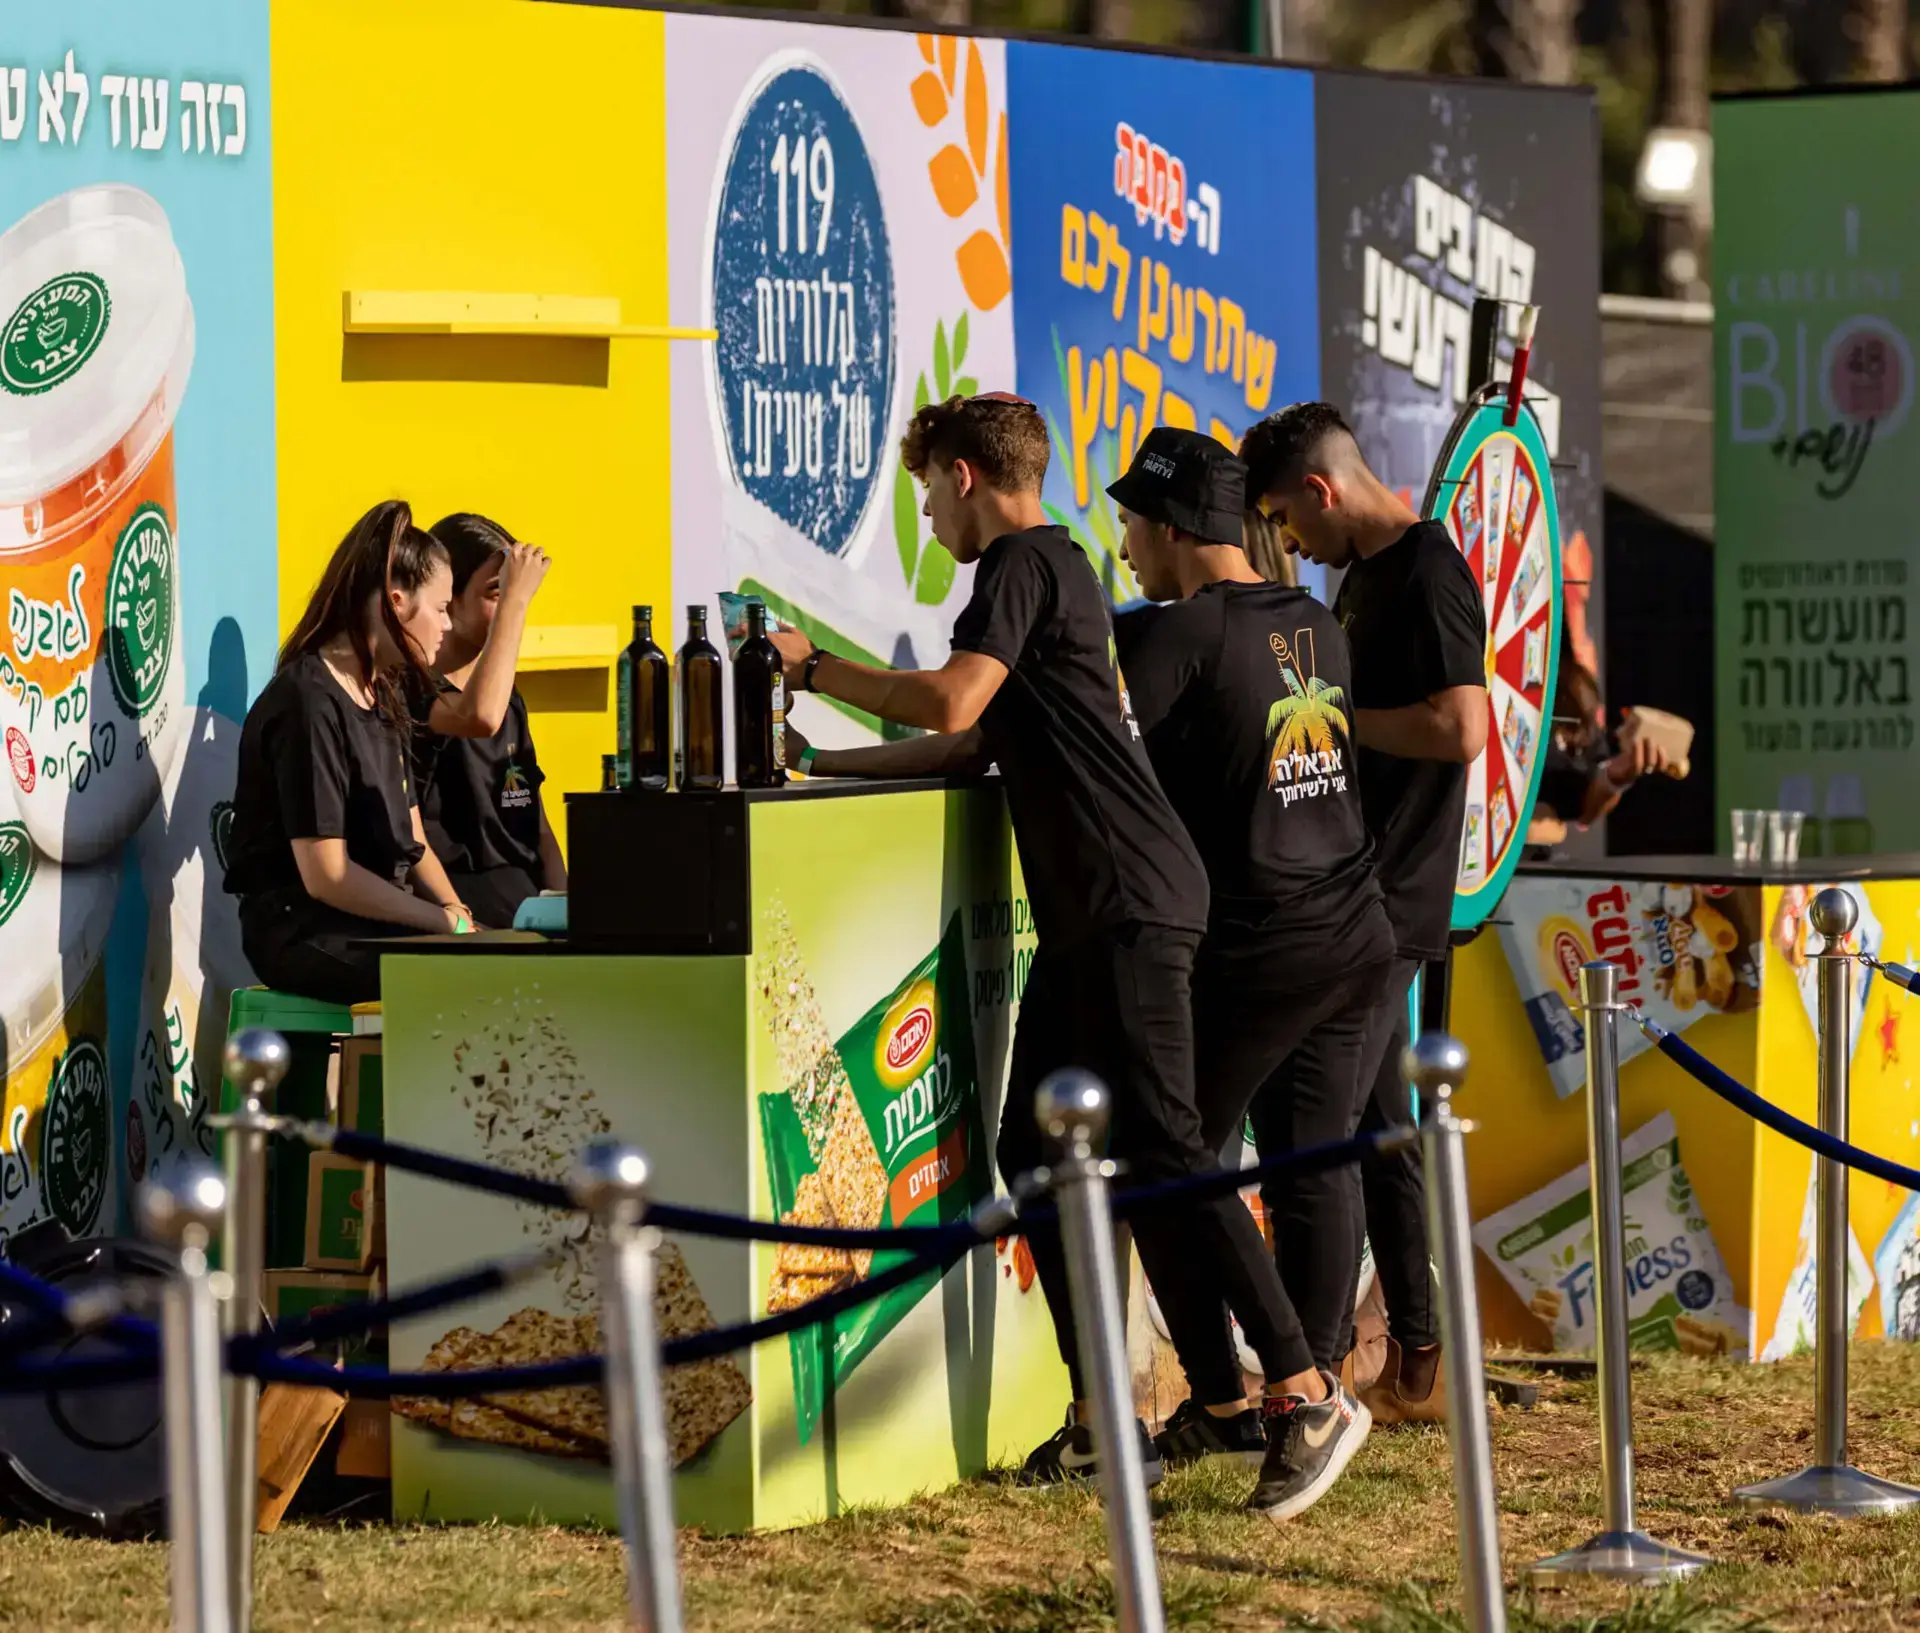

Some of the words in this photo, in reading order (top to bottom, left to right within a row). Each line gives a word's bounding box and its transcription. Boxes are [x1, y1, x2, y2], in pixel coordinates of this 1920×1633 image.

[37, 48, 90, 147] לא
[100, 73, 170, 151] עוד
[180, 80, 247, 156] כזה
[770, 133, 835, 256] 119
[1060, 203, 1131, 322] לכם
[10, 284, 92, 344] המעדניה
[30, 338, 78, 376] צבר
[755, 270, 856, 384] קלוריות
[1137, 256, 1277, 412] שתרענן
[743, 379, 823, 478] טעים!
[832, 379, 871, 479] של
[116, 528, 168, 629] המעדניה
[1740, 595, 1907, 647] מועשרת
[135, 638, 164, 693] צבר
[1738, 649, 1912, 708] באלוורה
[51, 1059, 102, 1164] המעדניה
[883, 1045, 951, 1154] לחמית
[908, 1155, 951, 1199] אגוזים
